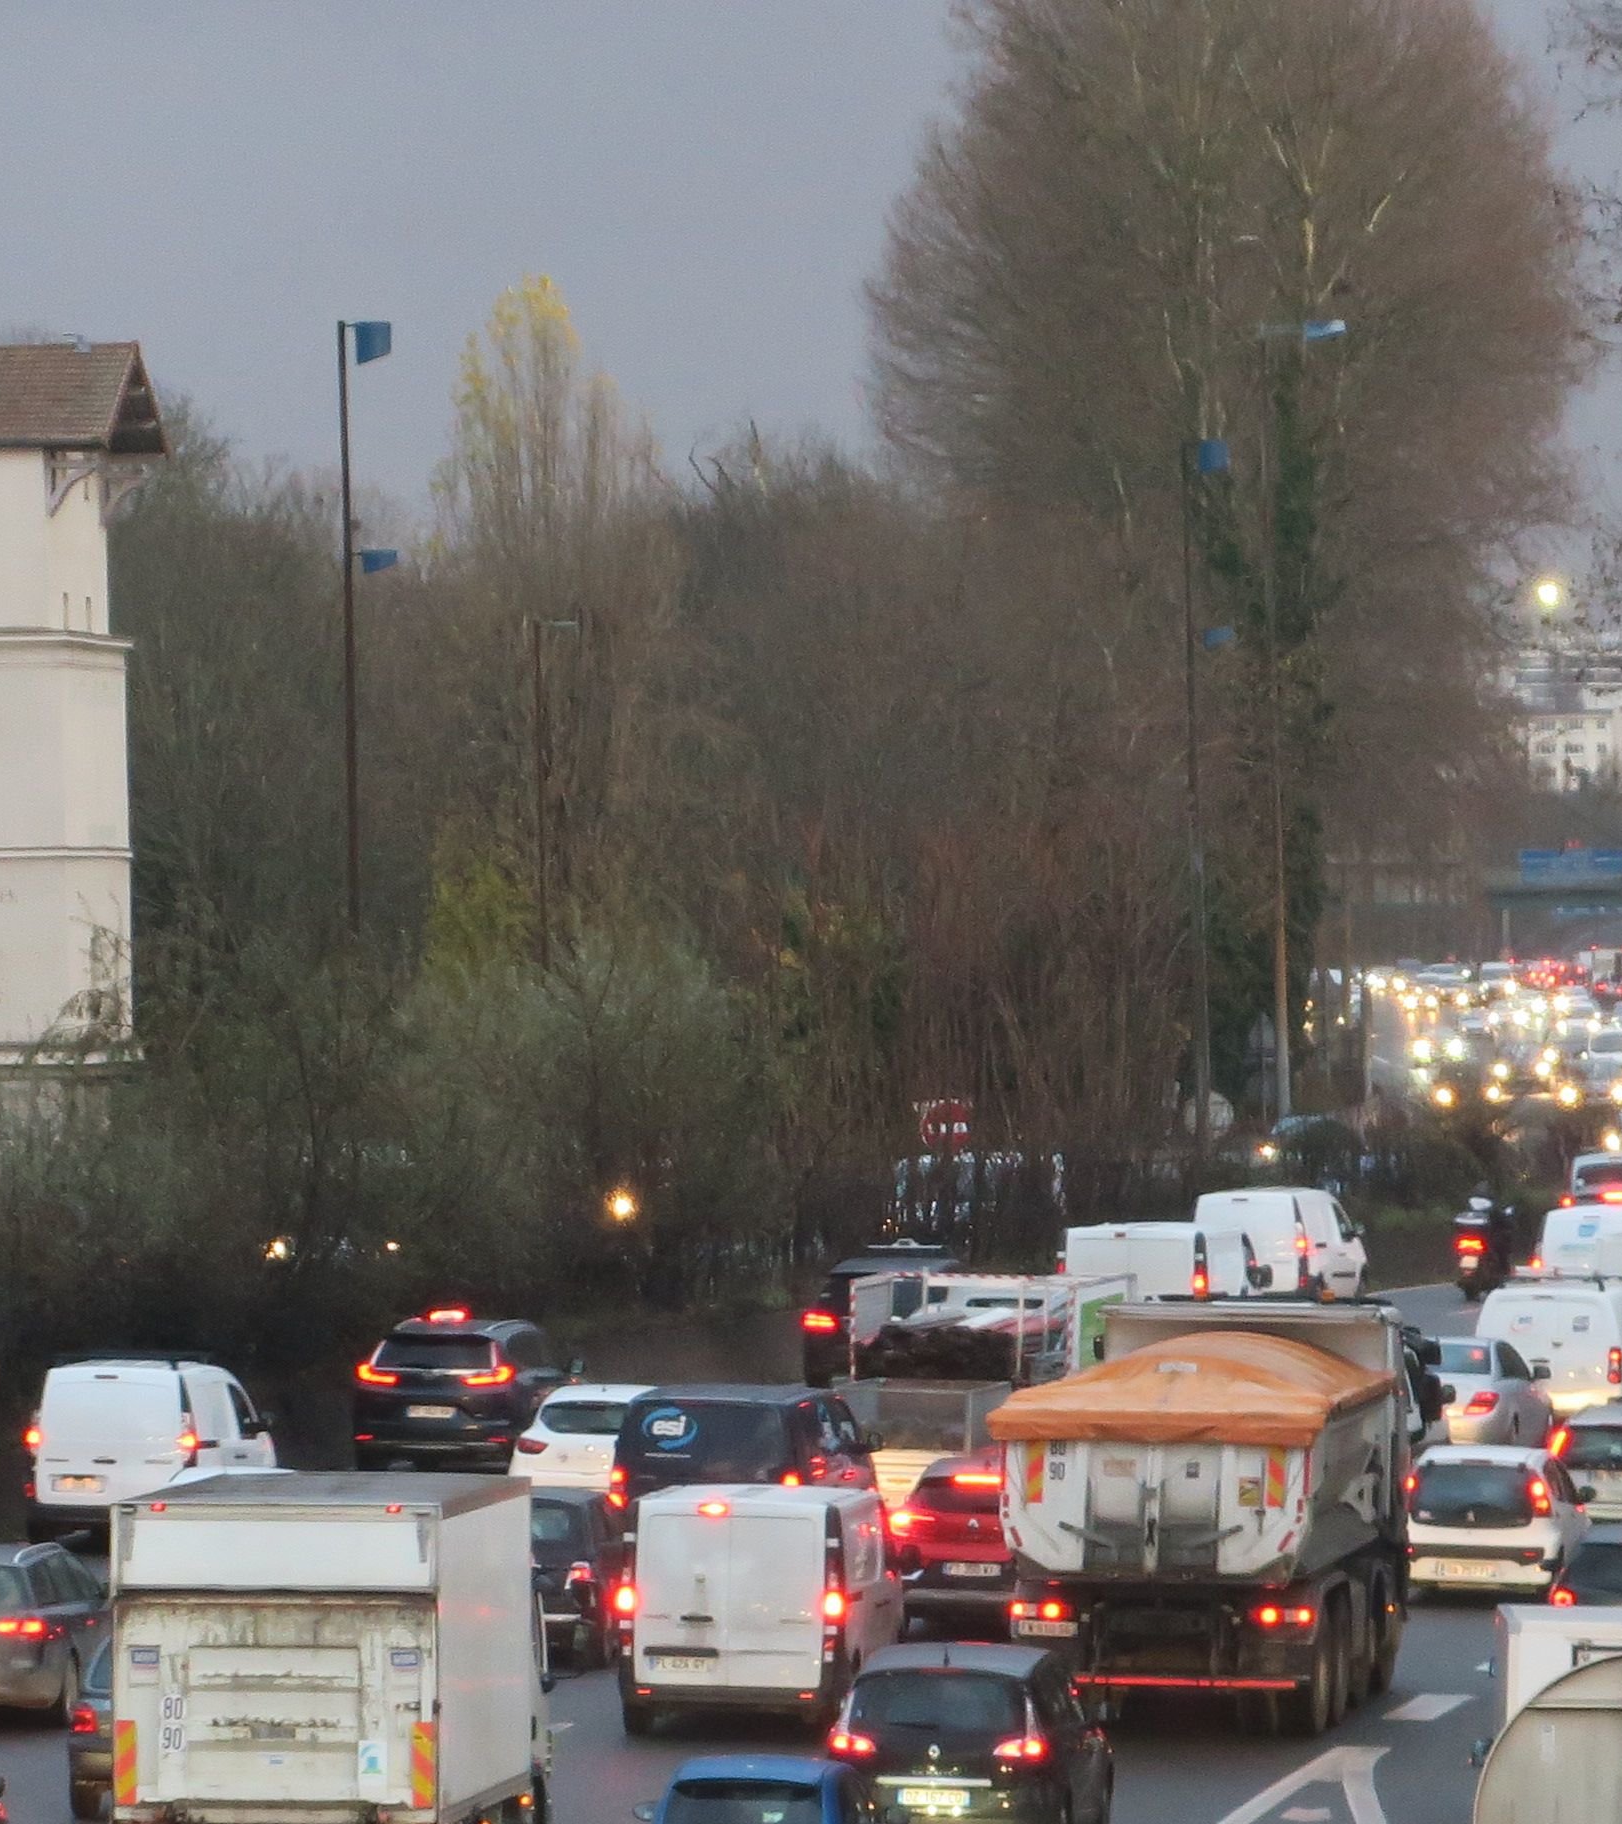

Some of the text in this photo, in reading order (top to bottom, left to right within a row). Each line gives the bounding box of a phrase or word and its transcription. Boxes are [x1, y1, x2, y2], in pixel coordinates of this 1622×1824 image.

[1049, 1461, 1066, 1481] 90
[163, 1696, 184, 1720] 80
[162, 1727, 183, 1750] 90
